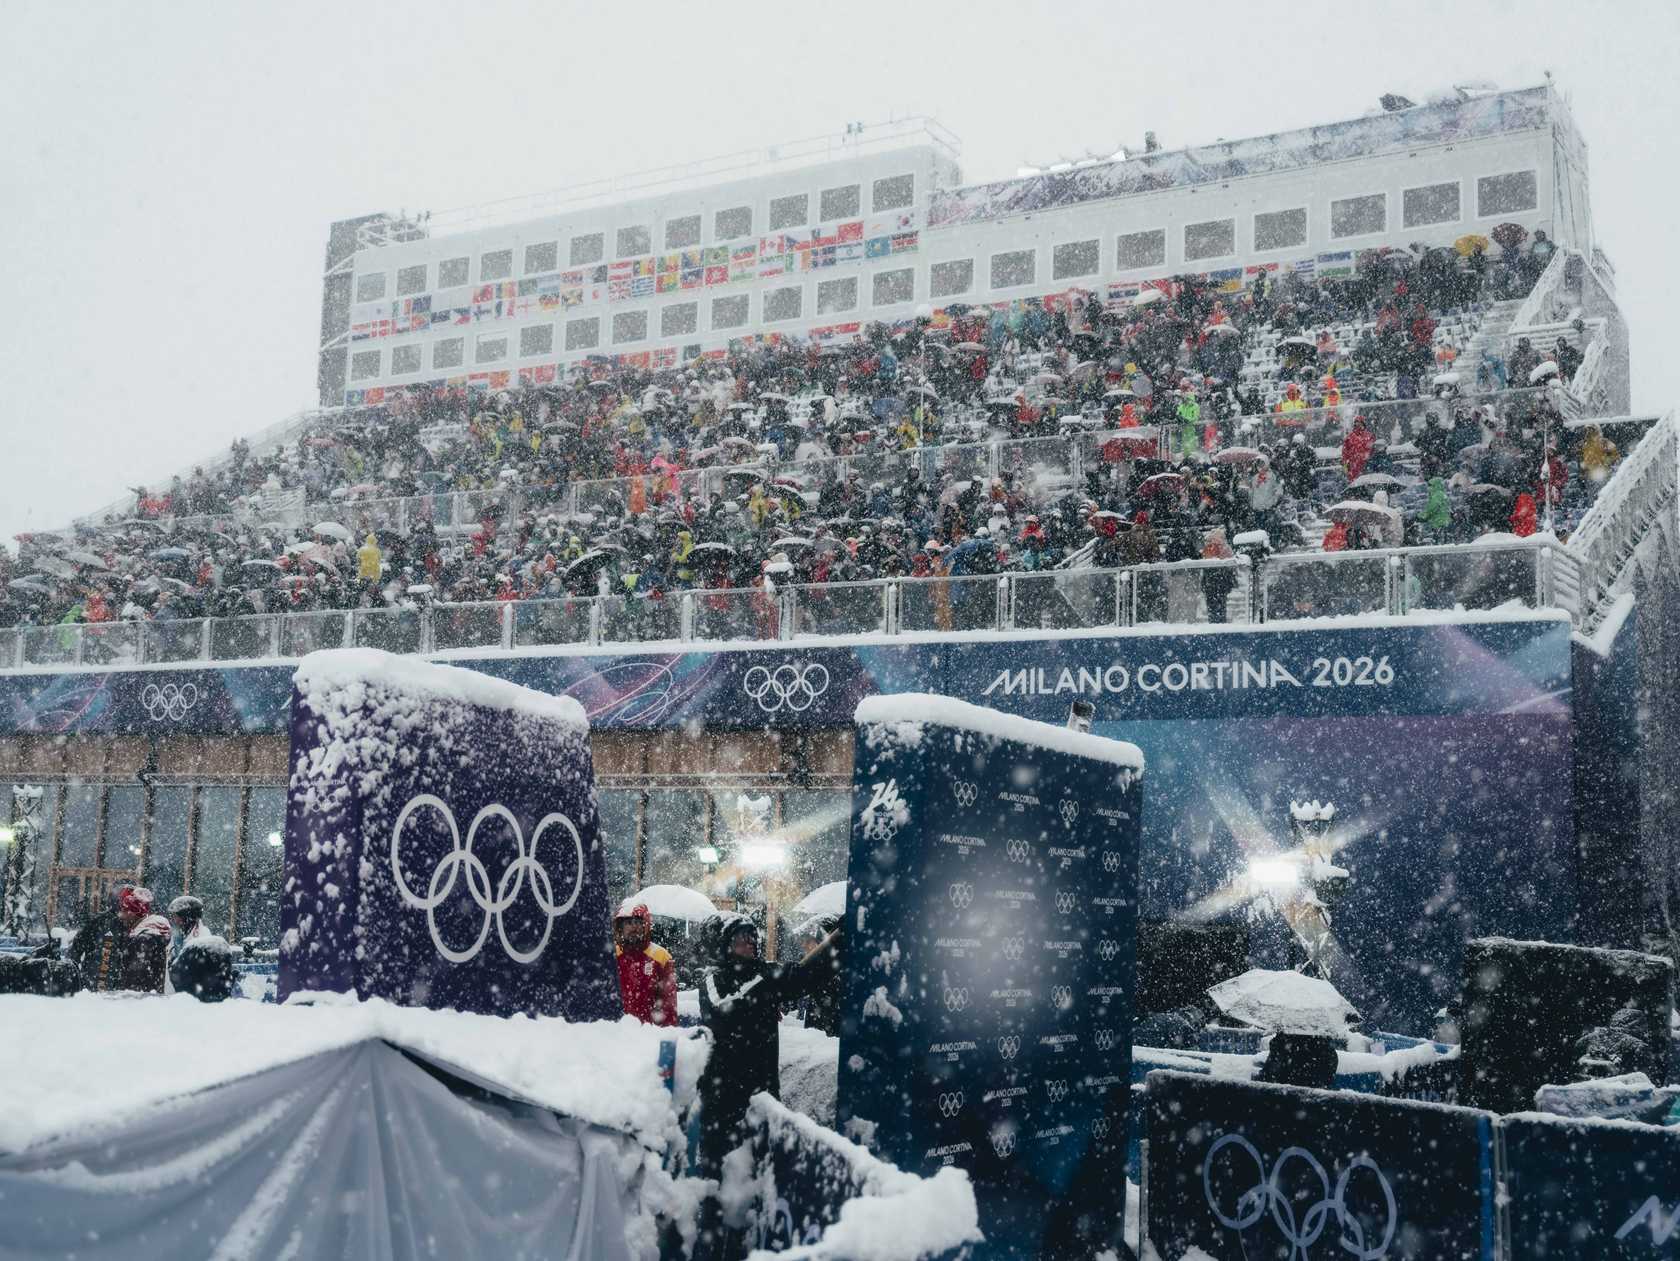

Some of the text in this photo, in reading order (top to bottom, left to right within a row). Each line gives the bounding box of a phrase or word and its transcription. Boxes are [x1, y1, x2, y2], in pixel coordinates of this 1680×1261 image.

[982, 655, 1395, 696] MILANO CORTINA 2026
[998, 791, 1040, 806] MILANO CORTINA
[929, 1041, 977, 1053] MILANO CORTINA
[1007, 1087, 1028, 1097] CORTINA
[924, 1142, 973, 1159] MILANO CORTINA
